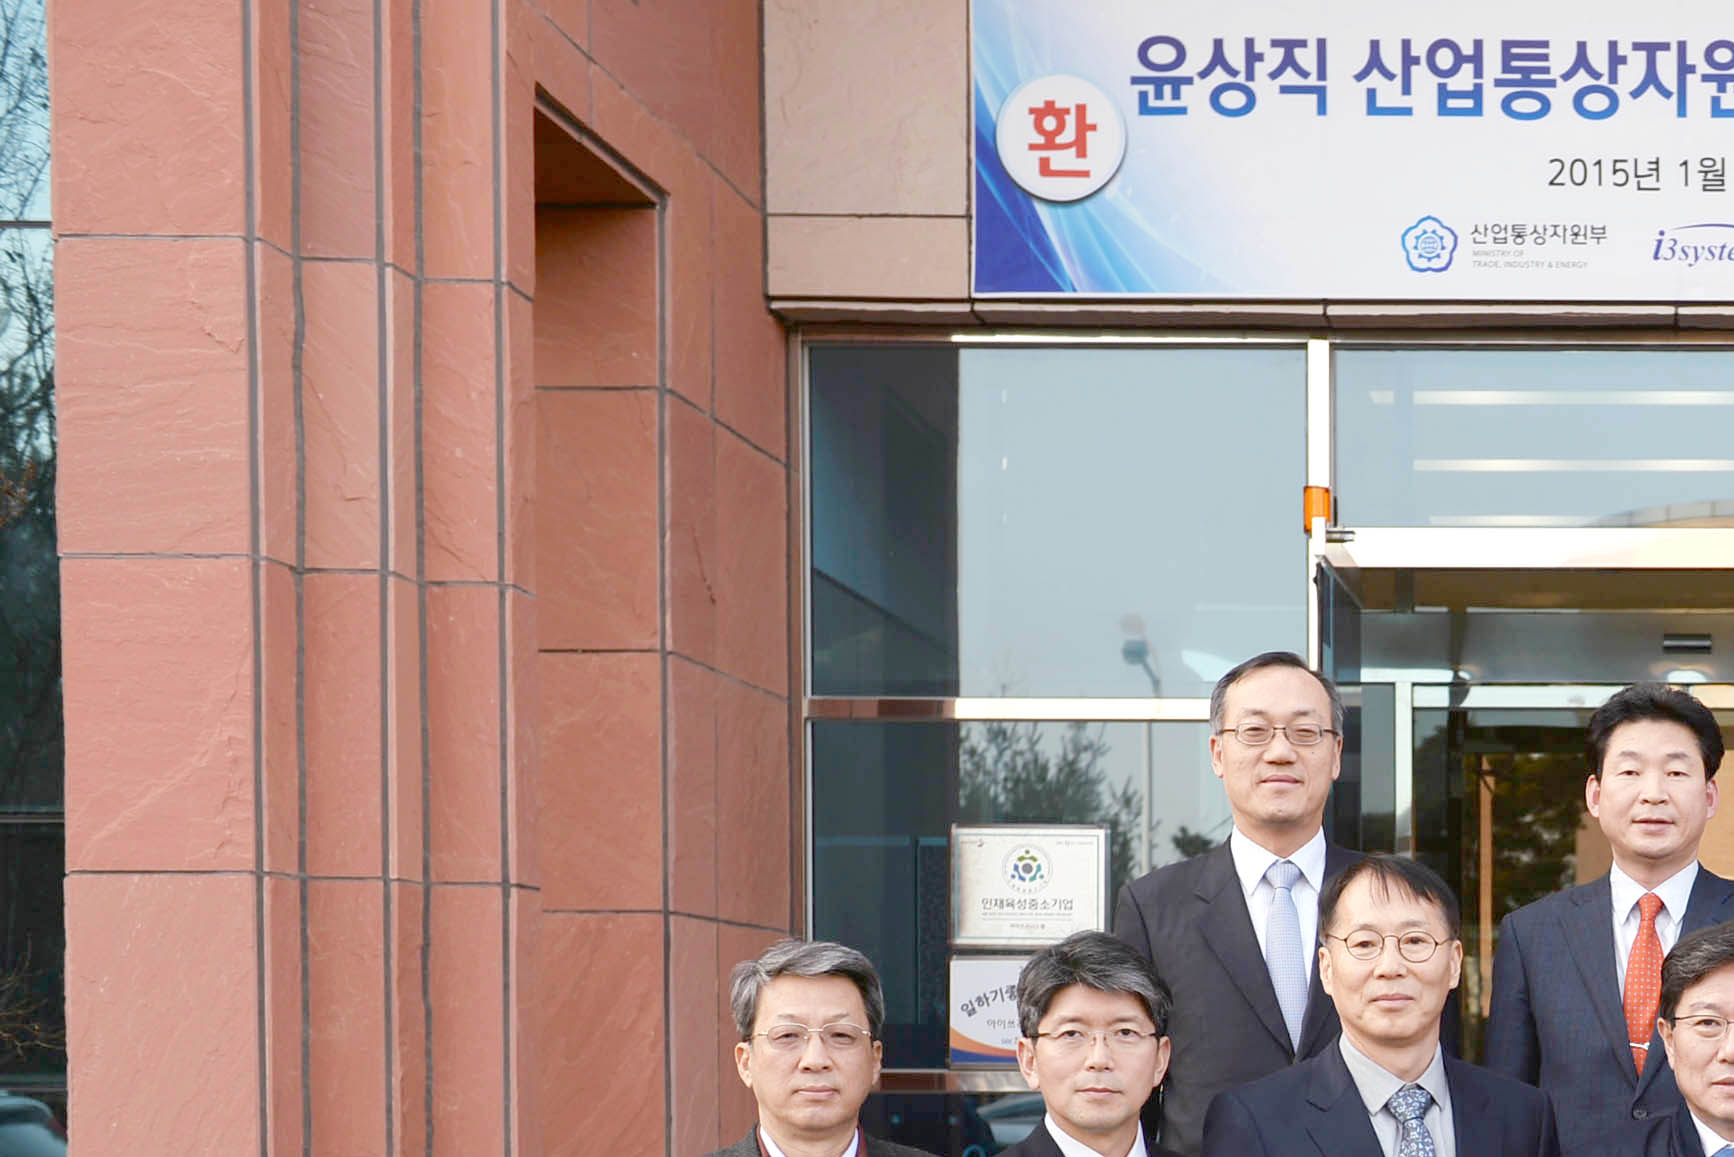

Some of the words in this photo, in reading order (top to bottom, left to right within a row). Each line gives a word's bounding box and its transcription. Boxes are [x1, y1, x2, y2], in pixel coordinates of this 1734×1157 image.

[1129, 34, 1329, 119] 윤상직
[1028, 99, 1098, 178] 환
[1547, 156, 1662, 192] 2015년
[1679, 156, 1727, 192] 1월
[1470, 223, 1608, 246] 산업통상자원부
[1472, 249, 1511, 258] MINISTRY
